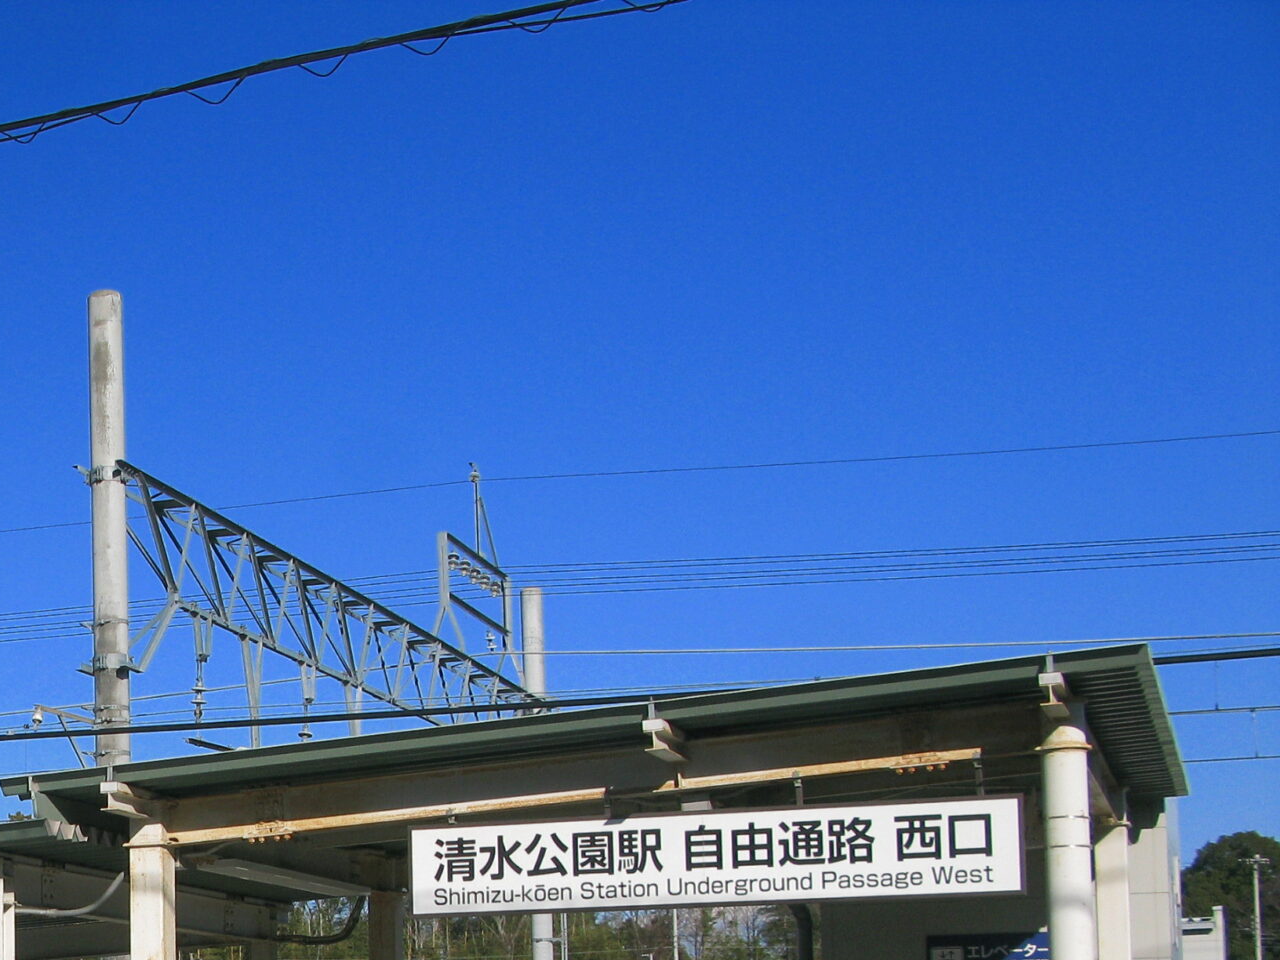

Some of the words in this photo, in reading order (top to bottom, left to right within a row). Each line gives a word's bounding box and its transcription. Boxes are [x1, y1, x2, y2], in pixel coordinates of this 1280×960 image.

[433, 828, 664, 883] 清水公園駅
[684, 816, 876, 872] 自由通路
[893, 813, 994, 862] 西口
[433, 884, 573, 906] Shimizu-kōen
[580, 879, 659, 900] Station
[666, 871, 813, 896] Underground
[821, 867, 924, 891] Passage
[931, 864, 995, 885] West
[967, 943, 1049, 959] エレベーター
